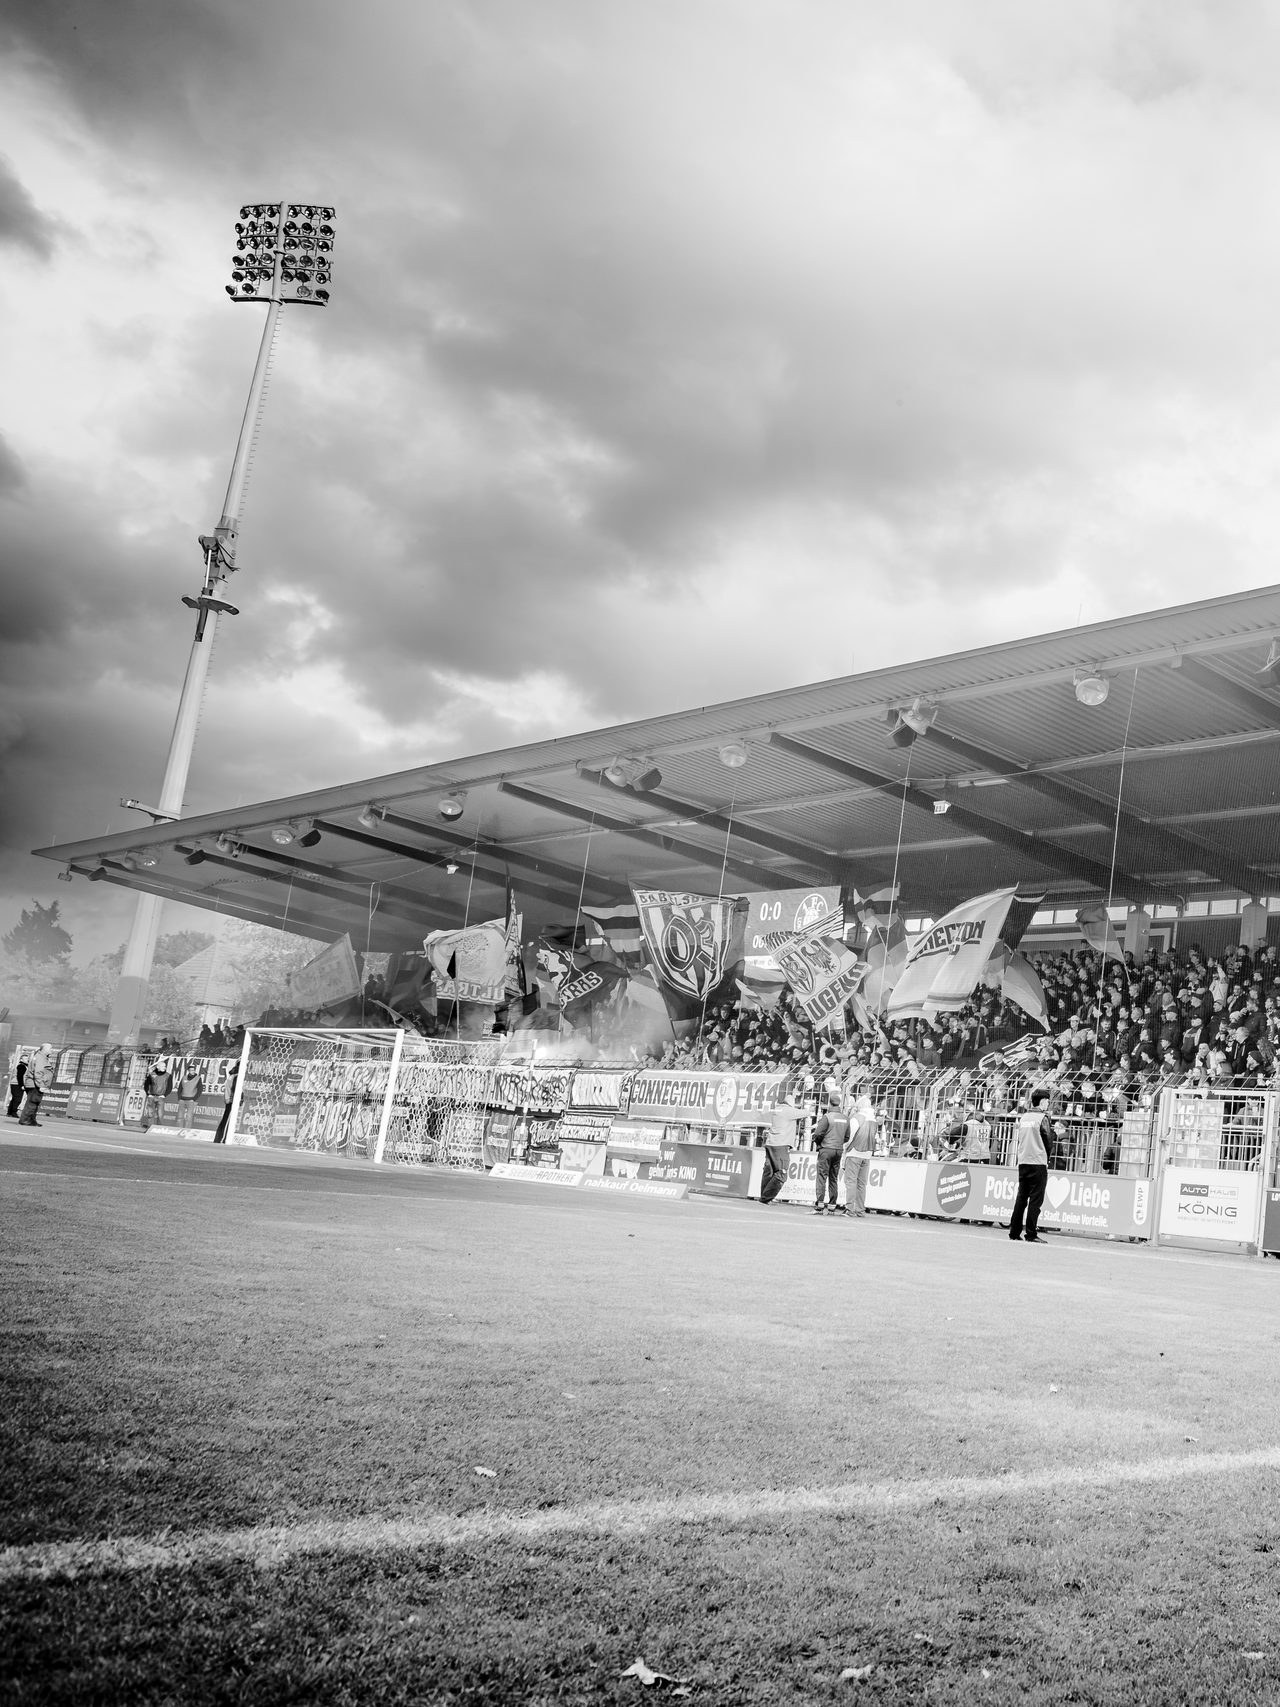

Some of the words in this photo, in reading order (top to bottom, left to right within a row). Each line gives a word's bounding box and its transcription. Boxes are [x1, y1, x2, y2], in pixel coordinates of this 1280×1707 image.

[760, 901, 781, 920] 0:0
[630, 1079, 710, 1108] CONNECTION
[128, 1096, 143, 1110] PRB
[678, 1166, 697, 1181] KINO
[584, 1178, 629, 1191] nahkauf
[1070, 1182, 1111, 1209] Liebe
[1178, 1200, 1237, 1217] KÖNIG
[1062, 1212, 1080, 1224] Deine
